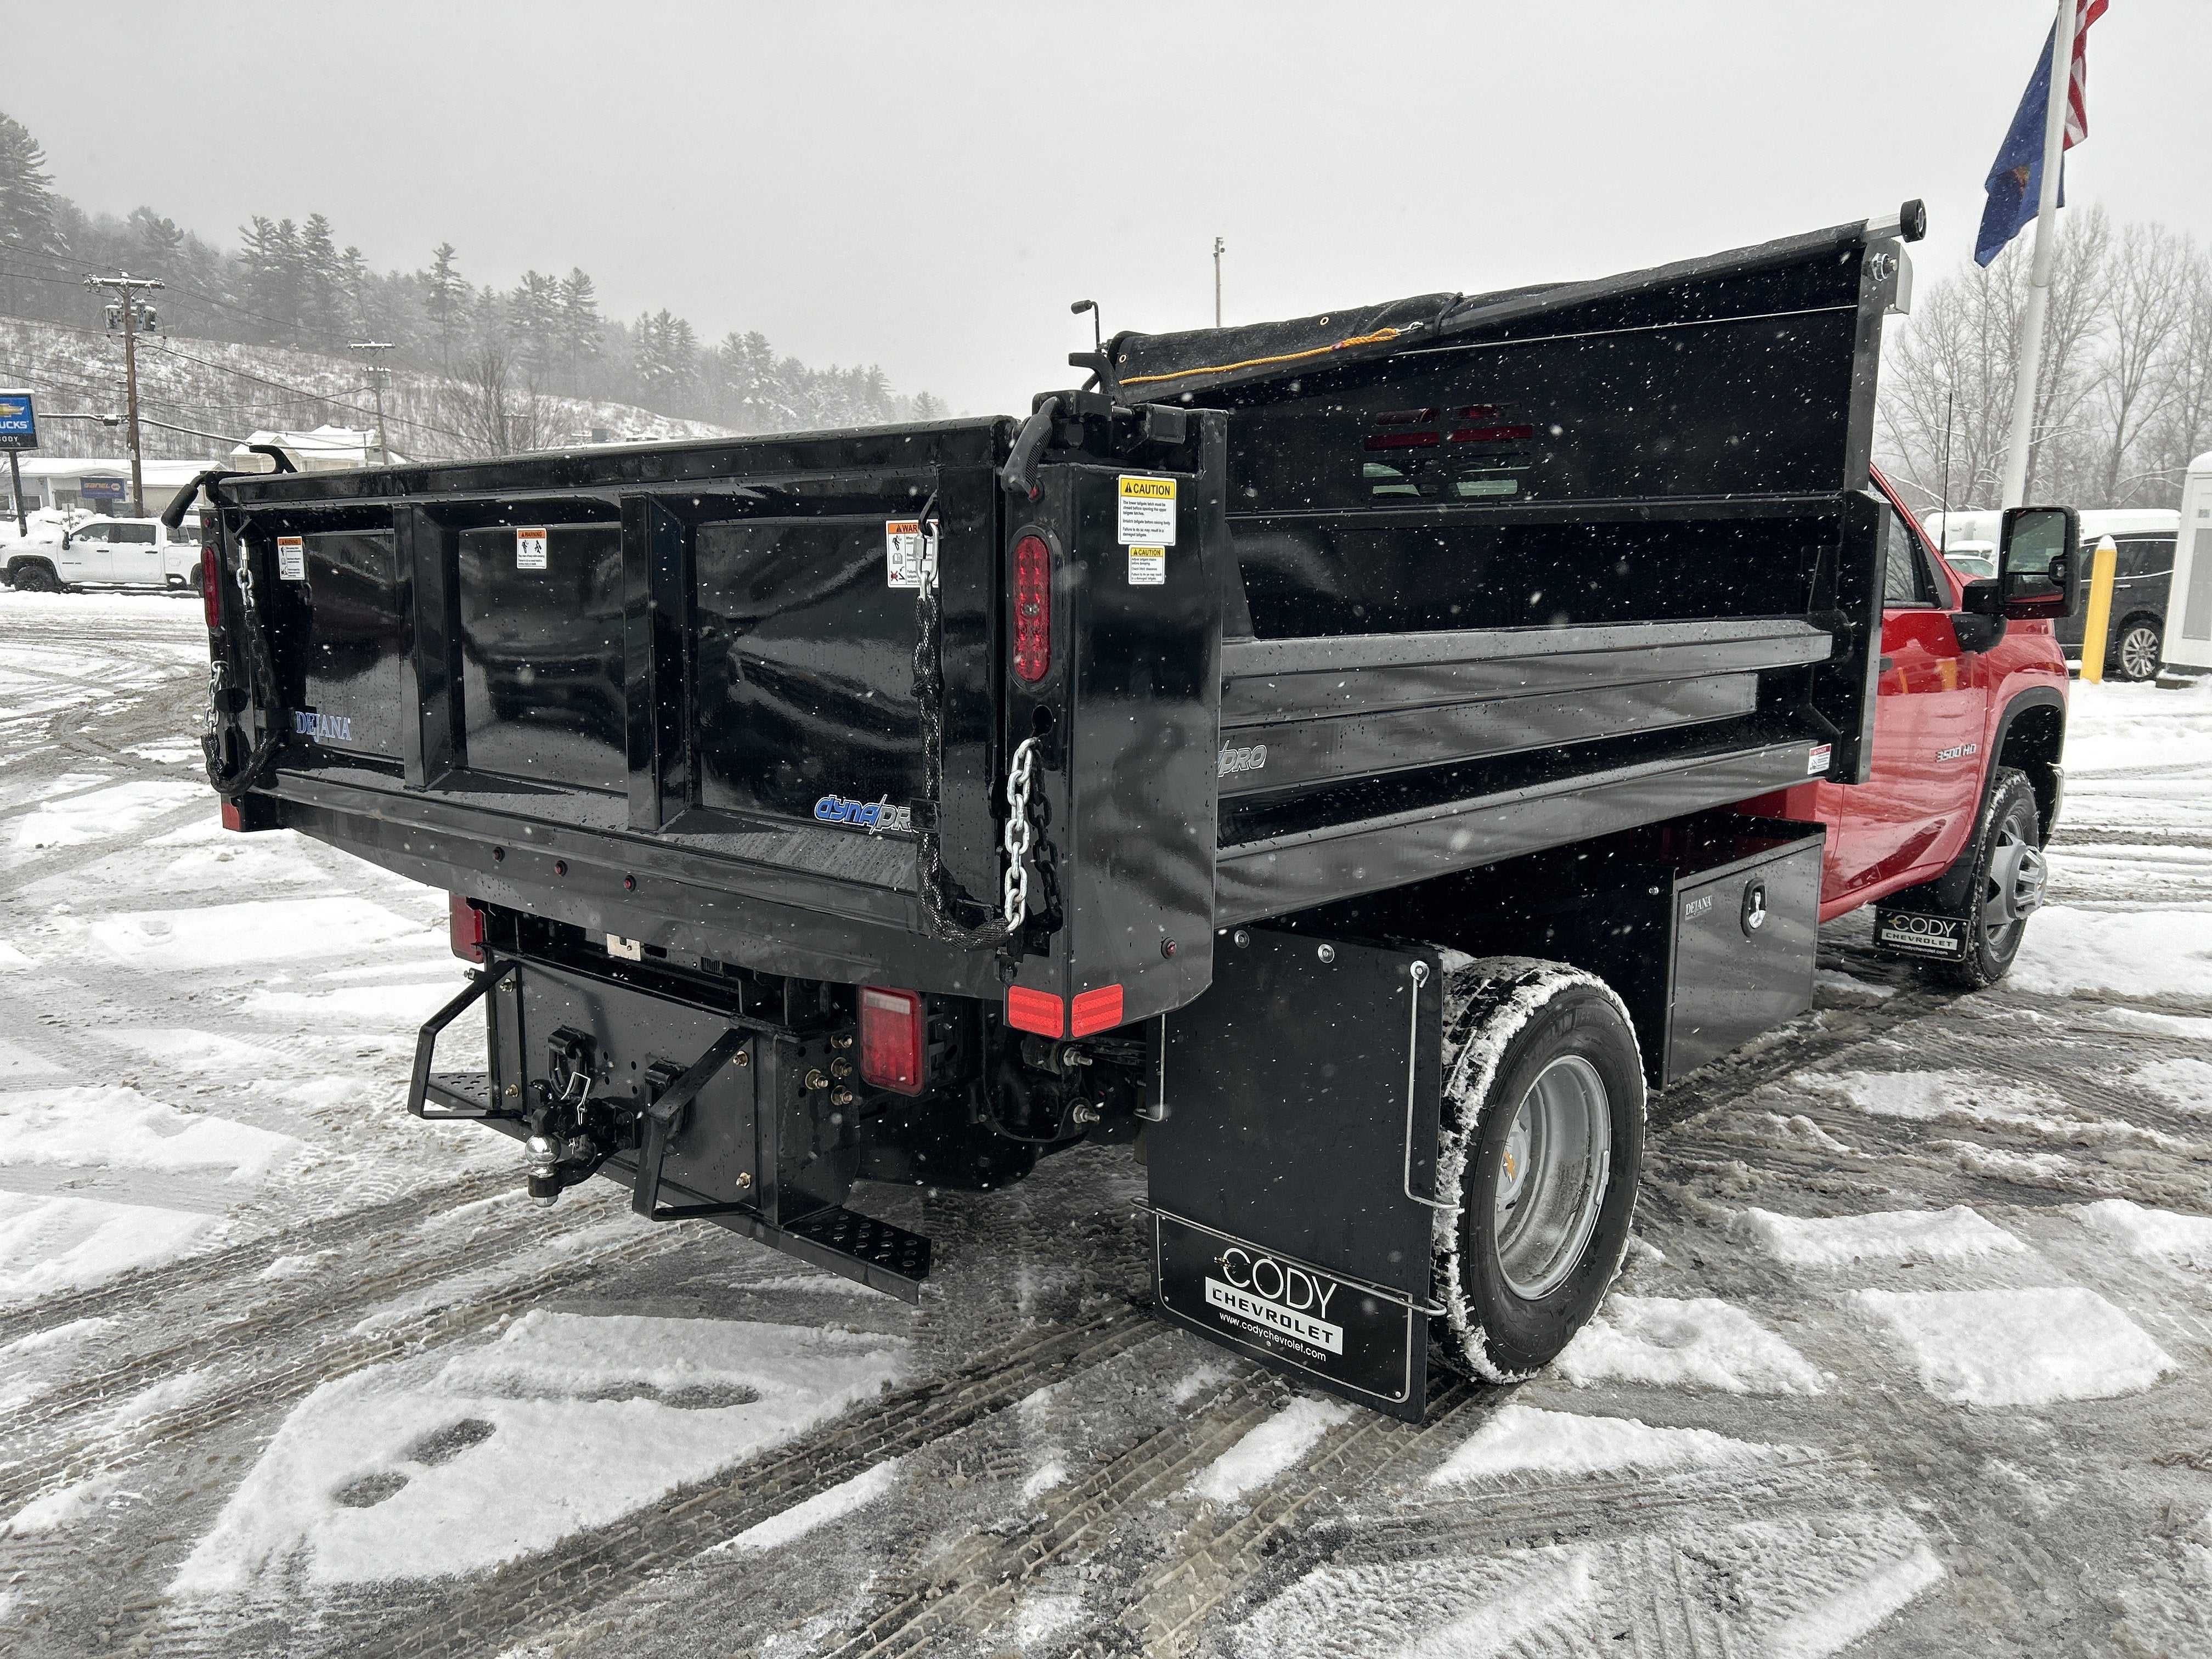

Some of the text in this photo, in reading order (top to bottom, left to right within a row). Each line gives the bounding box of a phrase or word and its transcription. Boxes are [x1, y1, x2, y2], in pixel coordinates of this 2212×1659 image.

[1133, 483, 1170, 496] CAUTION
[295, 711, 352, 743] DEJANA
[1218, 744, 1267, 777] PRO
[1935, 747, 1961, 763] 3500
[1685, 895, 1712, 916] DEJANA
[1886, 932, 1953, 947] CHEVROLET
[1893, 915, 1956, 937] CODY
[1222, 1248, 1337, 1319] CODY
[1212, 1287, 1333, 1344] CHEVROLET
[1219, 1312, 1326, 1362] www.codychevrolet.com
